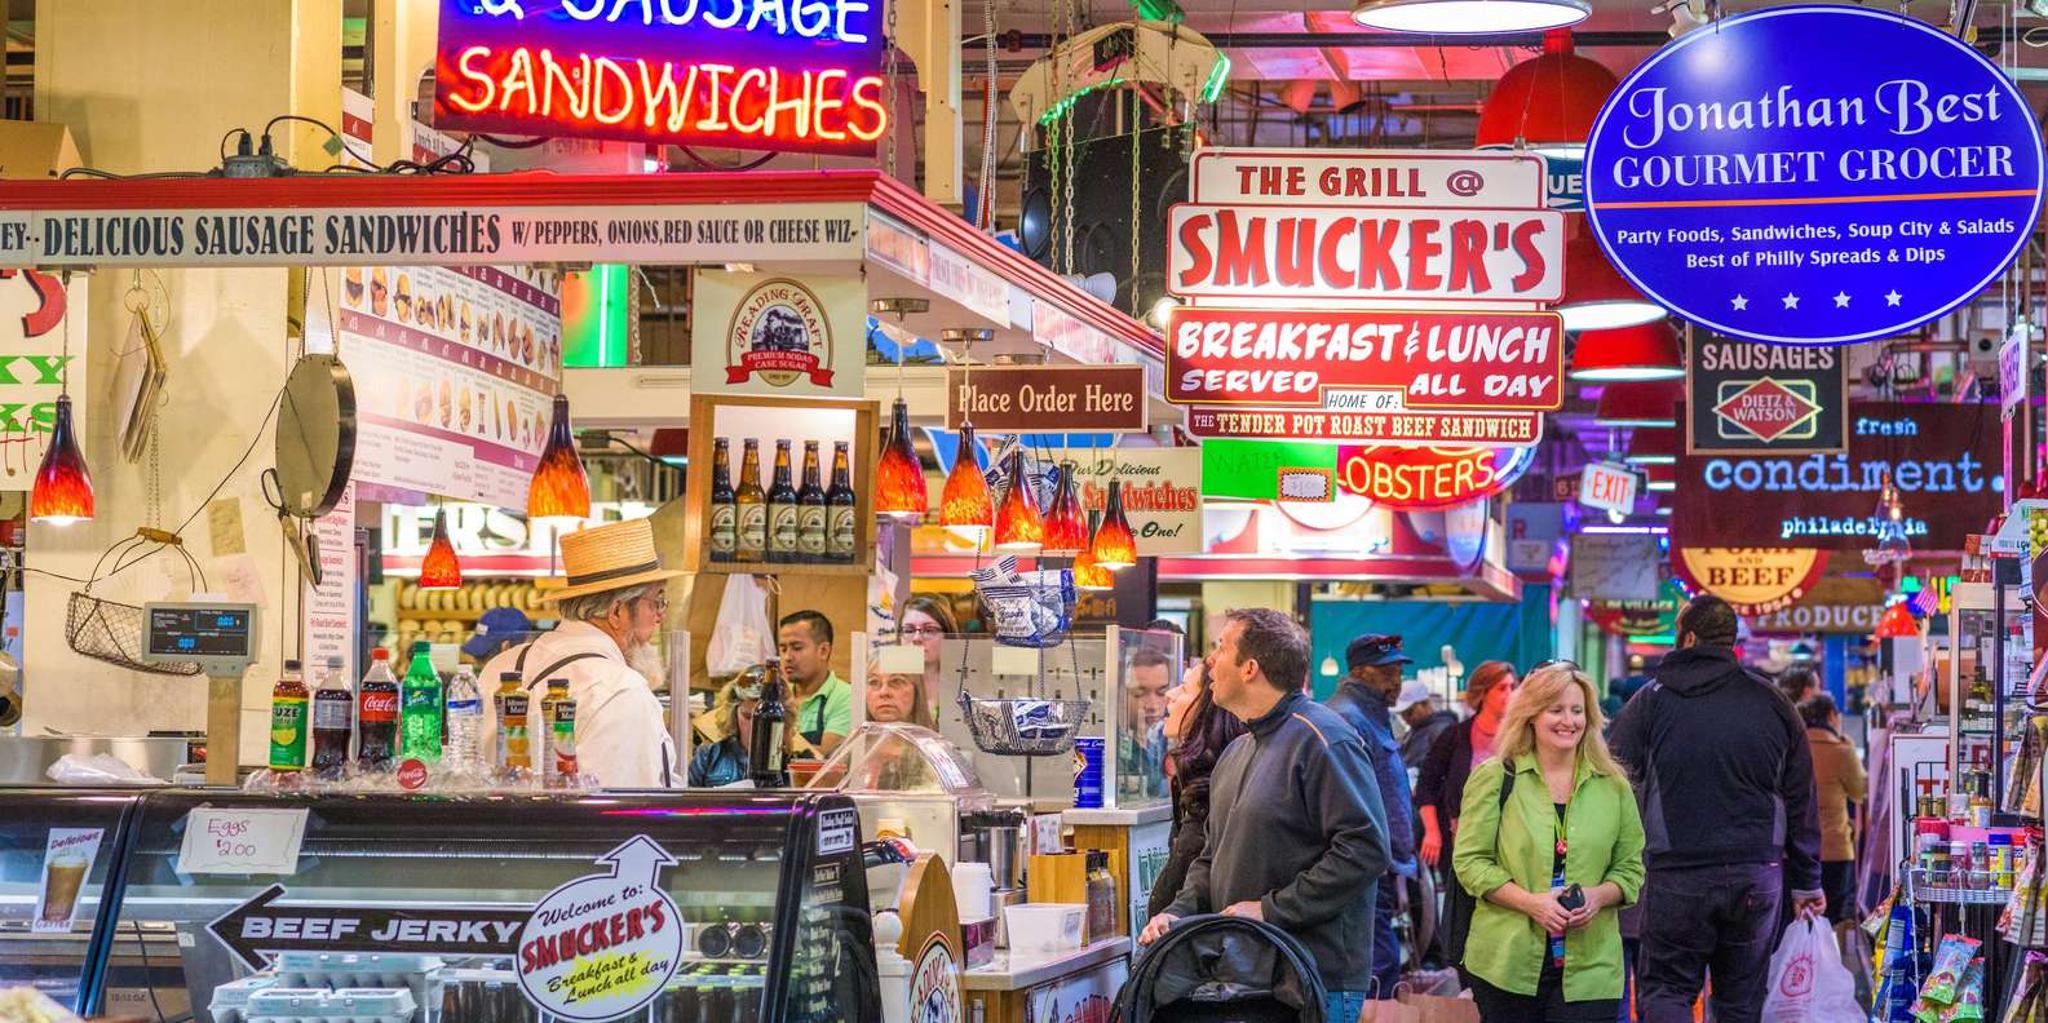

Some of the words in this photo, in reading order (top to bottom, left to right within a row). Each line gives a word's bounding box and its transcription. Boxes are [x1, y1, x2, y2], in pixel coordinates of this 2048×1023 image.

[449, 46, 888, 142] SANDWICHES
[1623, 85, 1866, 149] Jonathan
[1875, 79, 2003, 135] Best
[1236, 166, 1305, 195] THE
[1319, 166, 1426, 197] GRILL
[1446, 170, 1484, 196] @
[1613, 151, 1825, 188] GOURMET
[1839, 146, 2015, 182] GROCER
[44, 216, 184, 256] DELICIOUS
[195, 216, 314, 255] SAUSAGE
[325, 213, 500, 255] SANDWICHES
[512, 221, 530, 247] W/
[535, 220, 603, 248] PEPPERS,
[698, 218, 740, 244] SAUCE
[745, 219, 765, 243] OR
[770, 218, 820, 243] CHEESE
[1617, 228, 1662, 246] Party
[1667, 228, 1724, 244] Foods,
[1731, 226, 1842, 243] Sandwiches,
[1848, 223, 1893, 241] Soup
[1899, 221, 1933, 239] City
[1939, 221, 1951, 235] &
[1957, 217, 2015, 235] Salads
[1180, 210, 1546, 293] SMUCKER'S
[1687, 253, 1724, 269] Best
[1730, 251, 1750, 267] of
[1755, 249, 1805, 268] Philly
[1809, 248, 1881, 268] Spreads
[1887, 250, 1899, 263] &
[1906, 247, 1945, 264] Dips
[734, 287, 789, 348] READING
[792, 290, 823, 349] DRAFT
[1177, 322, 1403, 361] BREAKFAST
[1404, 321, 1419, 364] &
[1427, 326, 1552, 363] LUNCH
[1702, 344, 1834, 371] SAUSAGES
[958, 385, 1010, 412] Place
[1019, 384, 1077, 412] Order
[1085, 385, 1133, 412] Here
[1181, 369, 1318, 391] SERVED
[1409, 374, 1465, 396] ALL
[1484, 375, 1553, 397] DAY
[1328, 395, 1368, 408] HOME
[1376, 395, 1398, 409] OF:
[1733, 407, 1797, 420] WATSON
[1742, 395, 1782, 408] DIETZ
[1784, 394, 1796, 407] &
[1194, 415, 1214, 428] THE
[1217, 412, 1285, 433] TENDER
[1292, 415, 1325, 435] POT
[1331, 415, 1386, 436] ROAST
[1392, 416, 1434, 436] BEEF
[1441, 417, 1531, 438] SANDWICH
[1856, 418, 1917, 436] fresh
[1337, 452, 1494, 500] OBSTERS
[1591, 470, 1630, 504] EXIT
[1083, 480, 1198, 512] Sadwiches
[1141, 521, 1183, 538] One!
[1737, 557, 1763, 565] AND
[1707, 566, 1795, 587] BEEF
[208, 818, 249, 837] Eggs
[538, 896, 616, 926] Welcome
[622, 884, 643, 901] to:
[240, 917, 360, 939] BEEF
[372, 919, 523, 944] JERKY
[521, 899, 666, 975] SMUCKER'S
[547, 957, 627, 993] Breakfast
[562, 977, 613, 1006] Lunch
[613, 967, 637, 986] all
[641, 959, 670, 980] day
